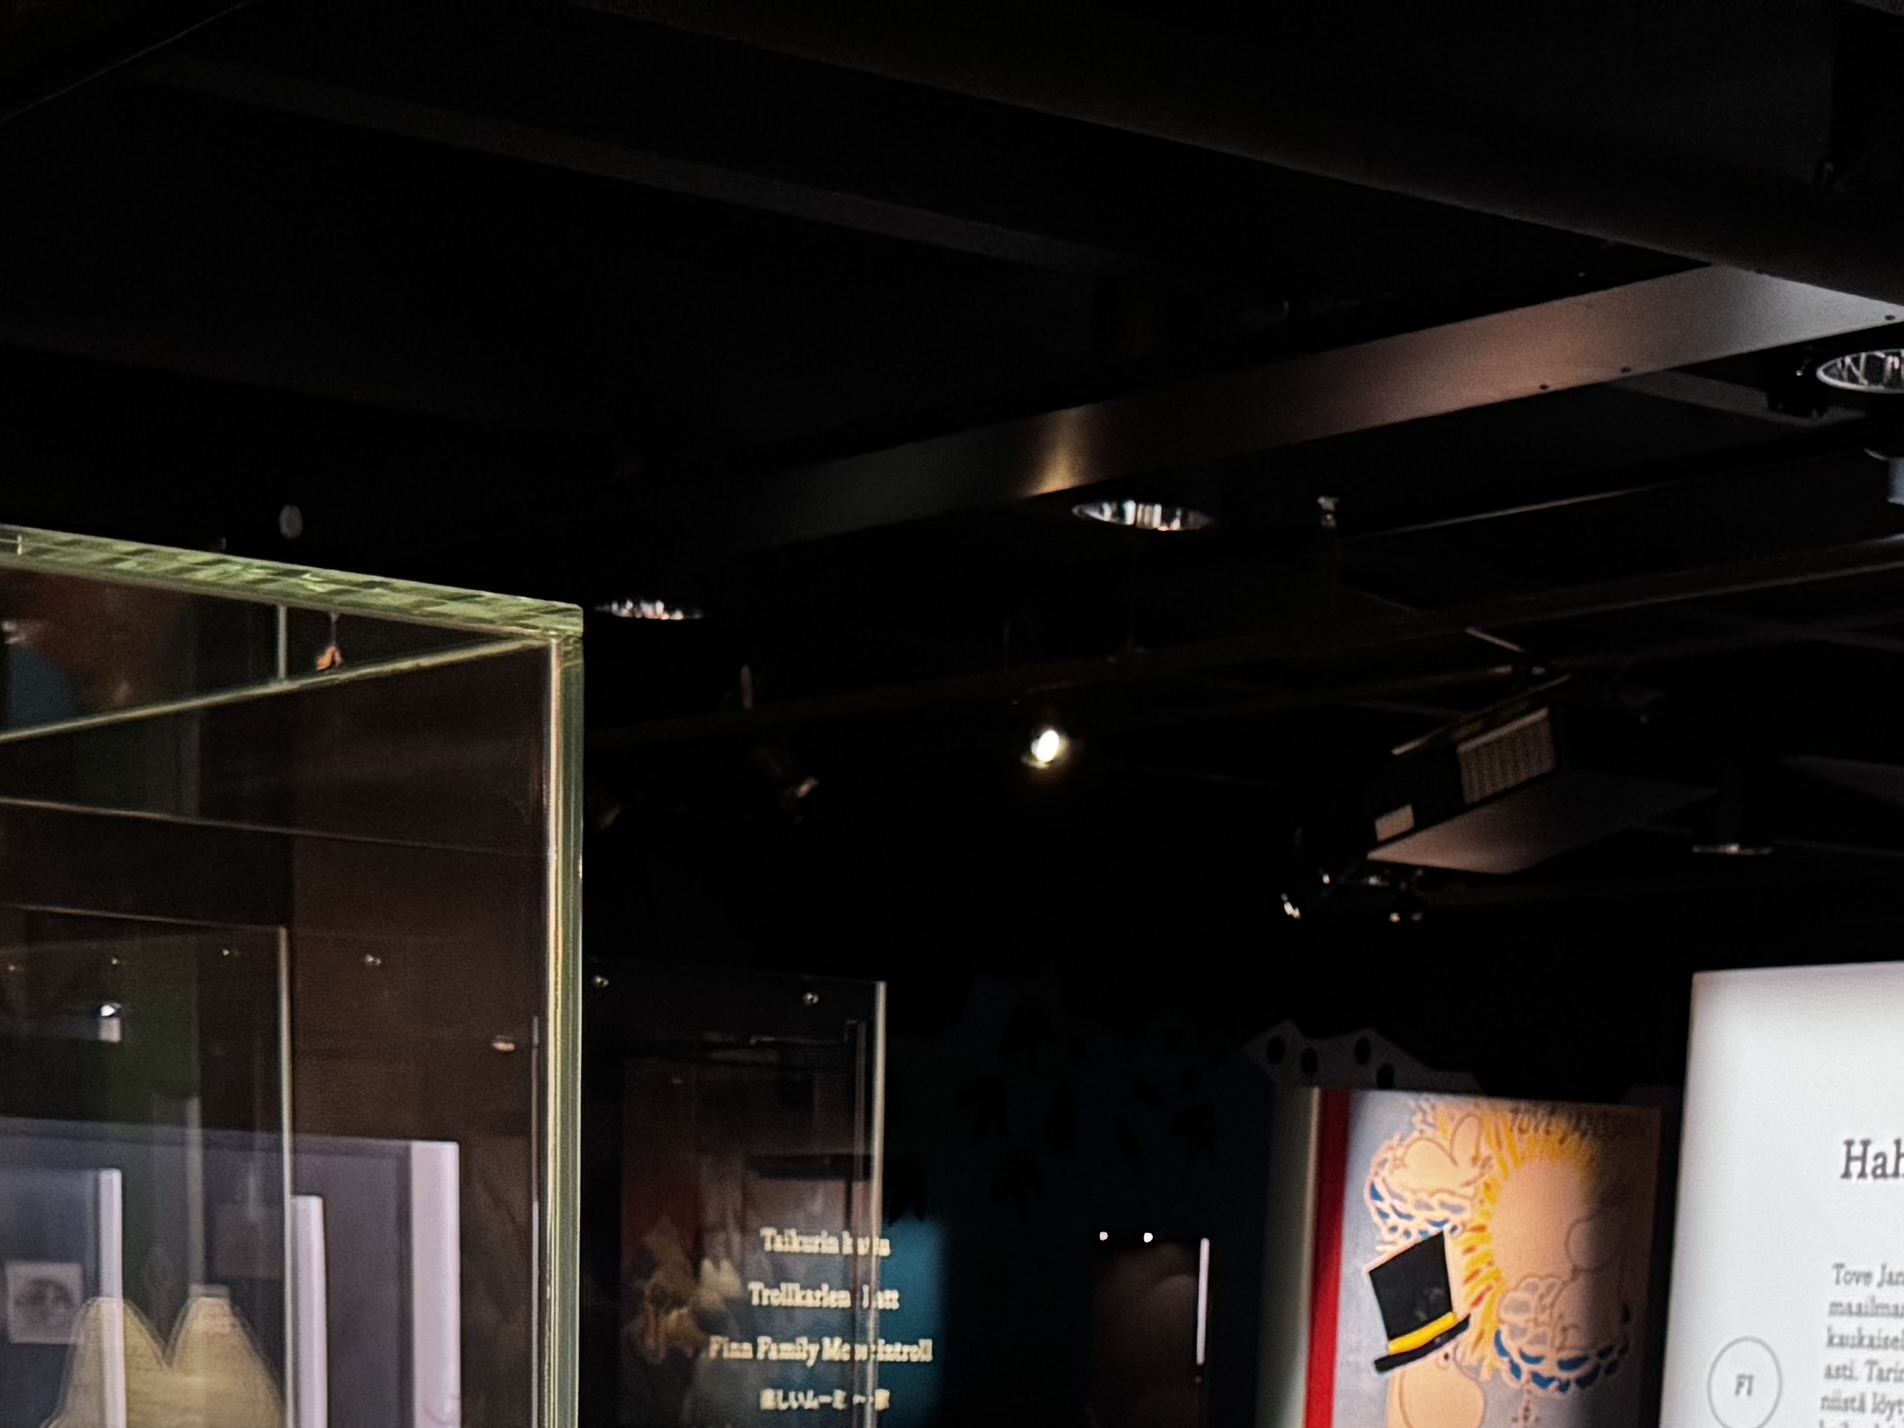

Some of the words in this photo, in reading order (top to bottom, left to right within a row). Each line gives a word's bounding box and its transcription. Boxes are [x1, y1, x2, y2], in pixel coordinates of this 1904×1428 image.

[1832, 1263, 1872, 1286] Tove
[757, 1336, 819, 1368] Family
[1824, 1360, 1858, 1381] asti.
[1735, 1375, 1754, 1397] FI
[1820, 1390, 1866, 1413] niistä
